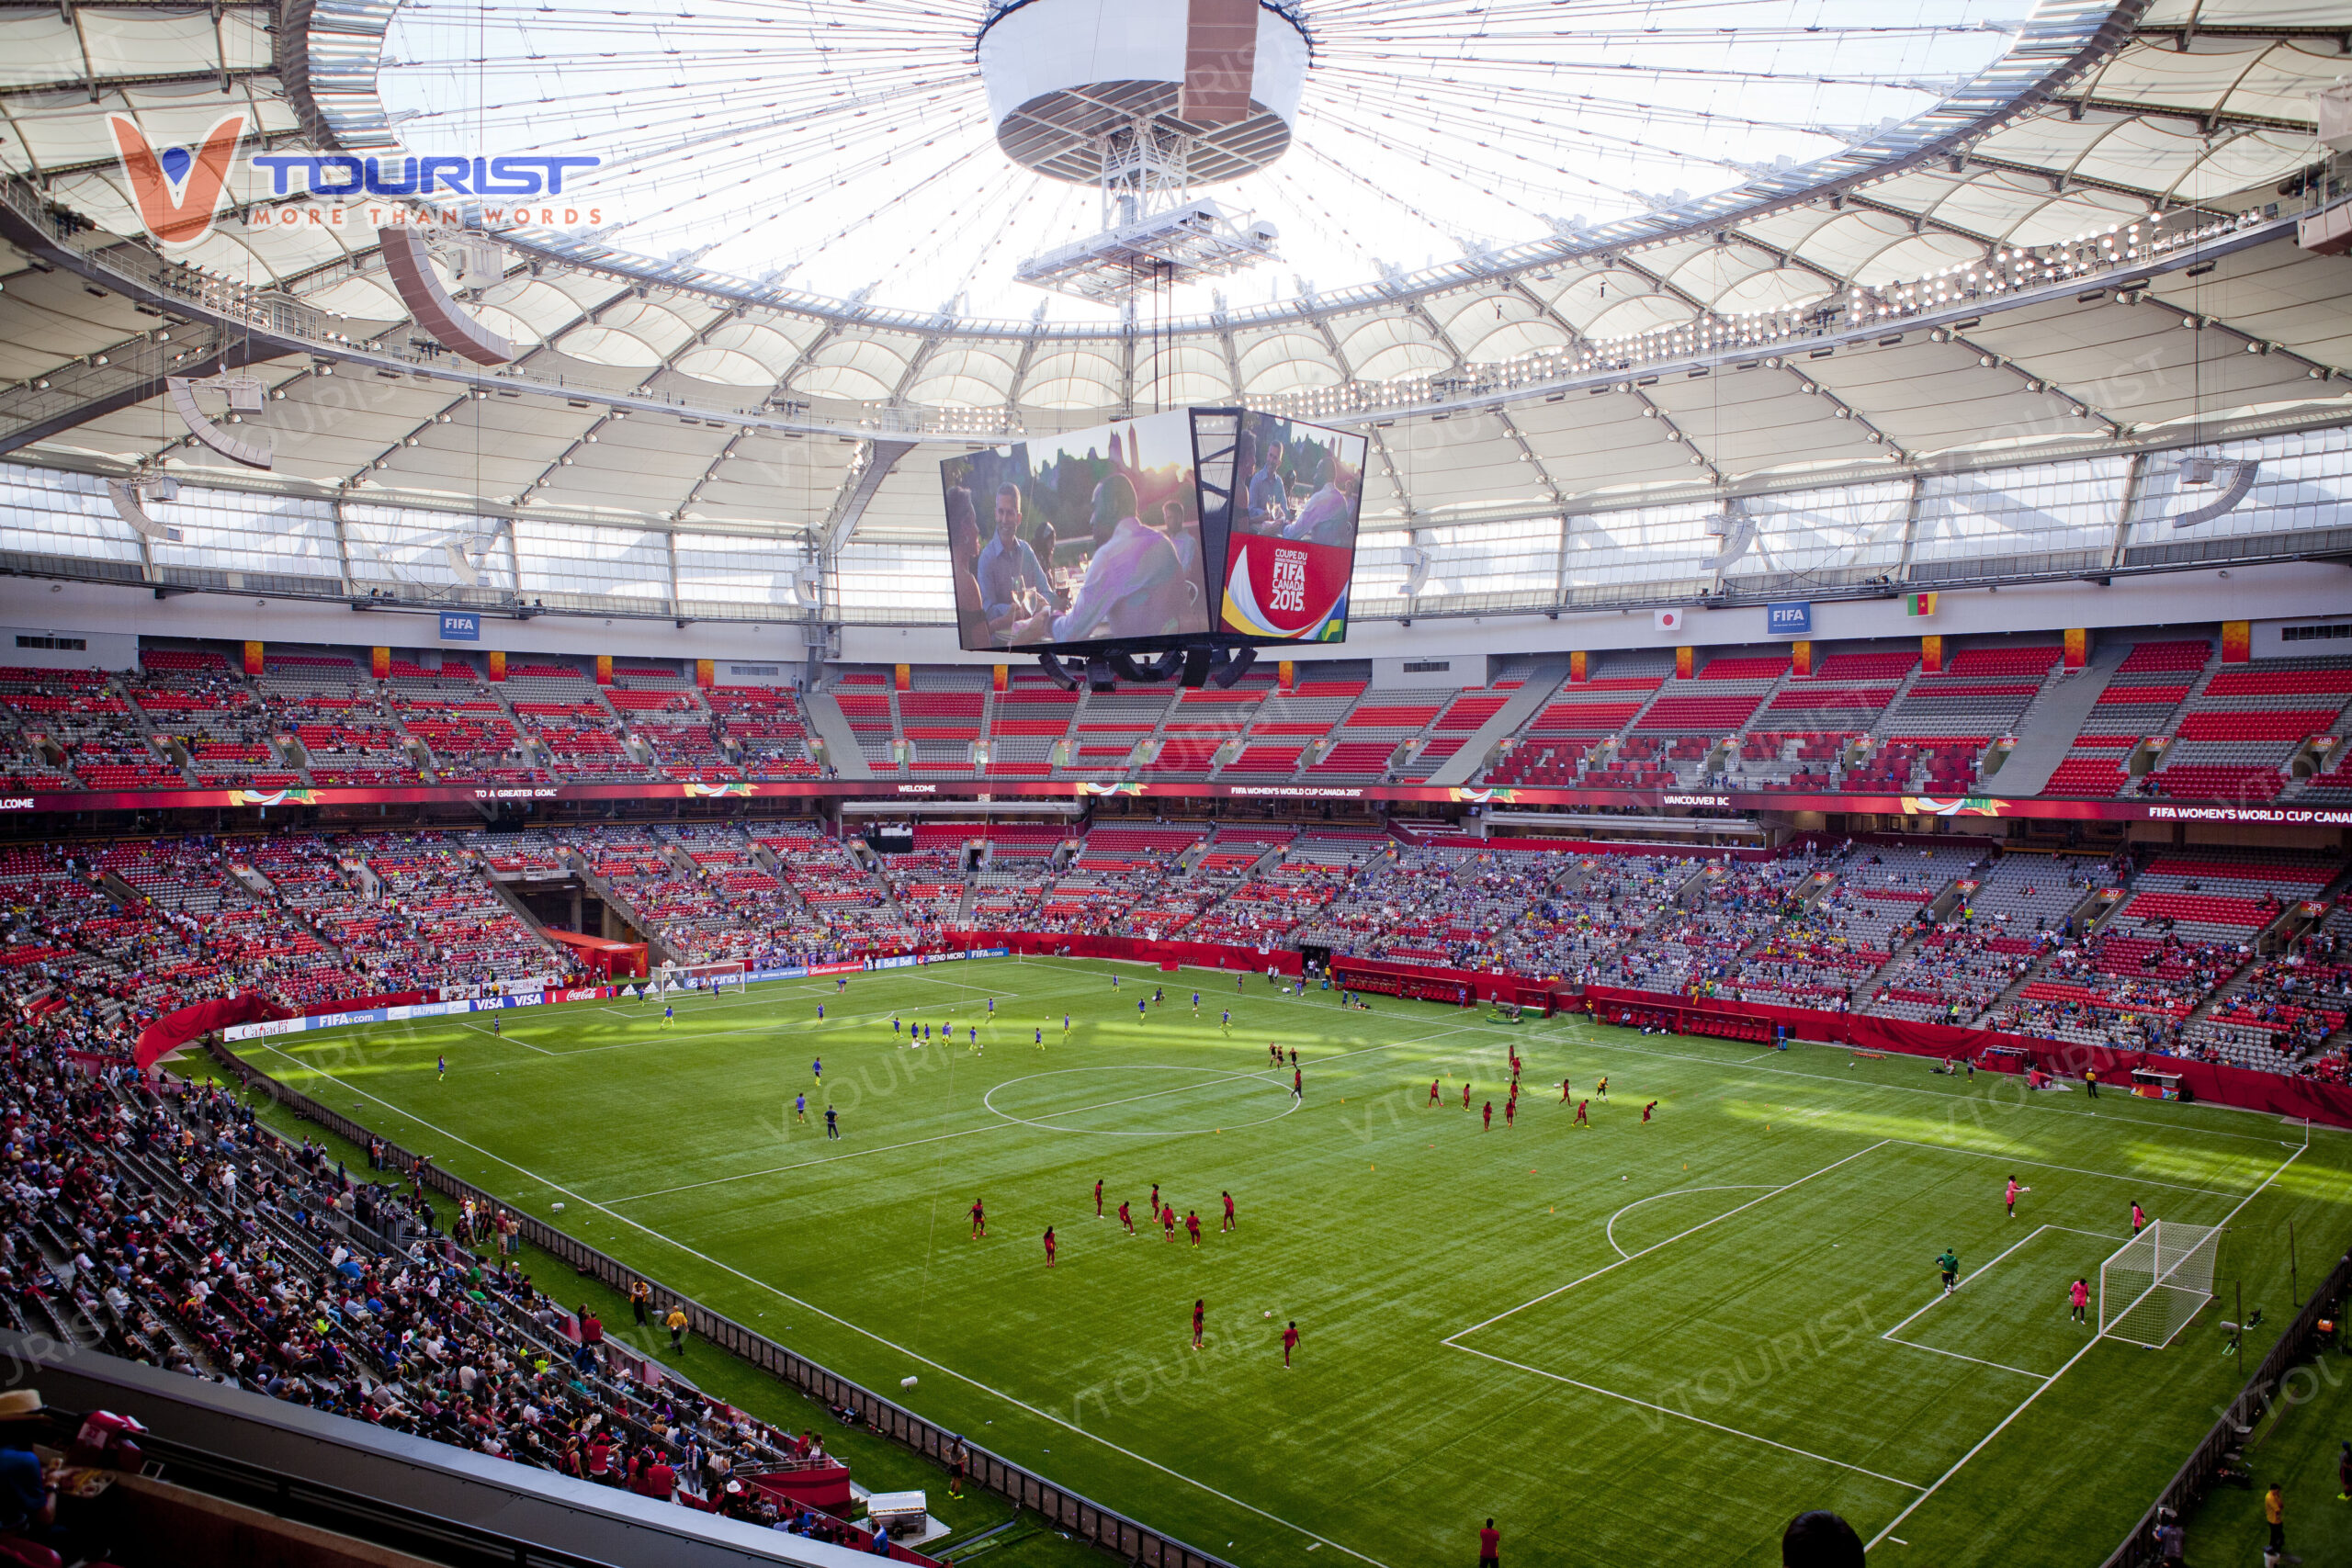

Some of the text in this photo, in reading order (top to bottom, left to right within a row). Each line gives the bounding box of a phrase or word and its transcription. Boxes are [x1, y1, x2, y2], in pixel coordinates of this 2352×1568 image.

[1275, 548, 1307, 560] COUPE DU
[1273, 561, 1305, 582] FIFA
[1272, 579, 1304, 592] CANADA
[1270, 589, 1305, 612] 2015
[1773, 609, 1804, 622] FIFA
[445, 617, 474, 630] FIFA
[2152, 738, 2165, 746] 417
[2317, 737, 2332, 745] 418
[475, 790, 486, 798] TO
[497, 789, 533, 797] GREATER
[898, 784, 936, 793] WELCOME
[1231, 786, 1247, 795] FIFA
[1247, 787, 1279, 795] WOMEN'S
[1280, 787, 1304, 795] WORLD
[1318, 788, 1346, 796] CANADA
[1663, 795, 1729, 806] VANCOUVER BC
[2149, 807, 2177, 818] FIFA
[2177, 807, 2236, 819] WOMEN'S
[2237, 809, 2284, 821] WORLD
[2286, 811, 2312, 822] CUP
[2106, 889, 2119, 897] 217
[927, 952, 965, 963] TREND MICRO
[971, 950, 1004, 959] FIFA.com
[867, 960, 880, 970] Bll
[884, 958, 897, 967] Bell
[899, 956, 912, 966] Bell
[809, 966, 840, 976] Budweiser
[474, 997, 505, 1010] VISA
[512, 993, 542, 1007] VISA
[413, 1003, 447, 1016] GAZPROM
[319, 1013, 374, 1028] FIFA.com
[243, 1021, 288, 1038] Canada
